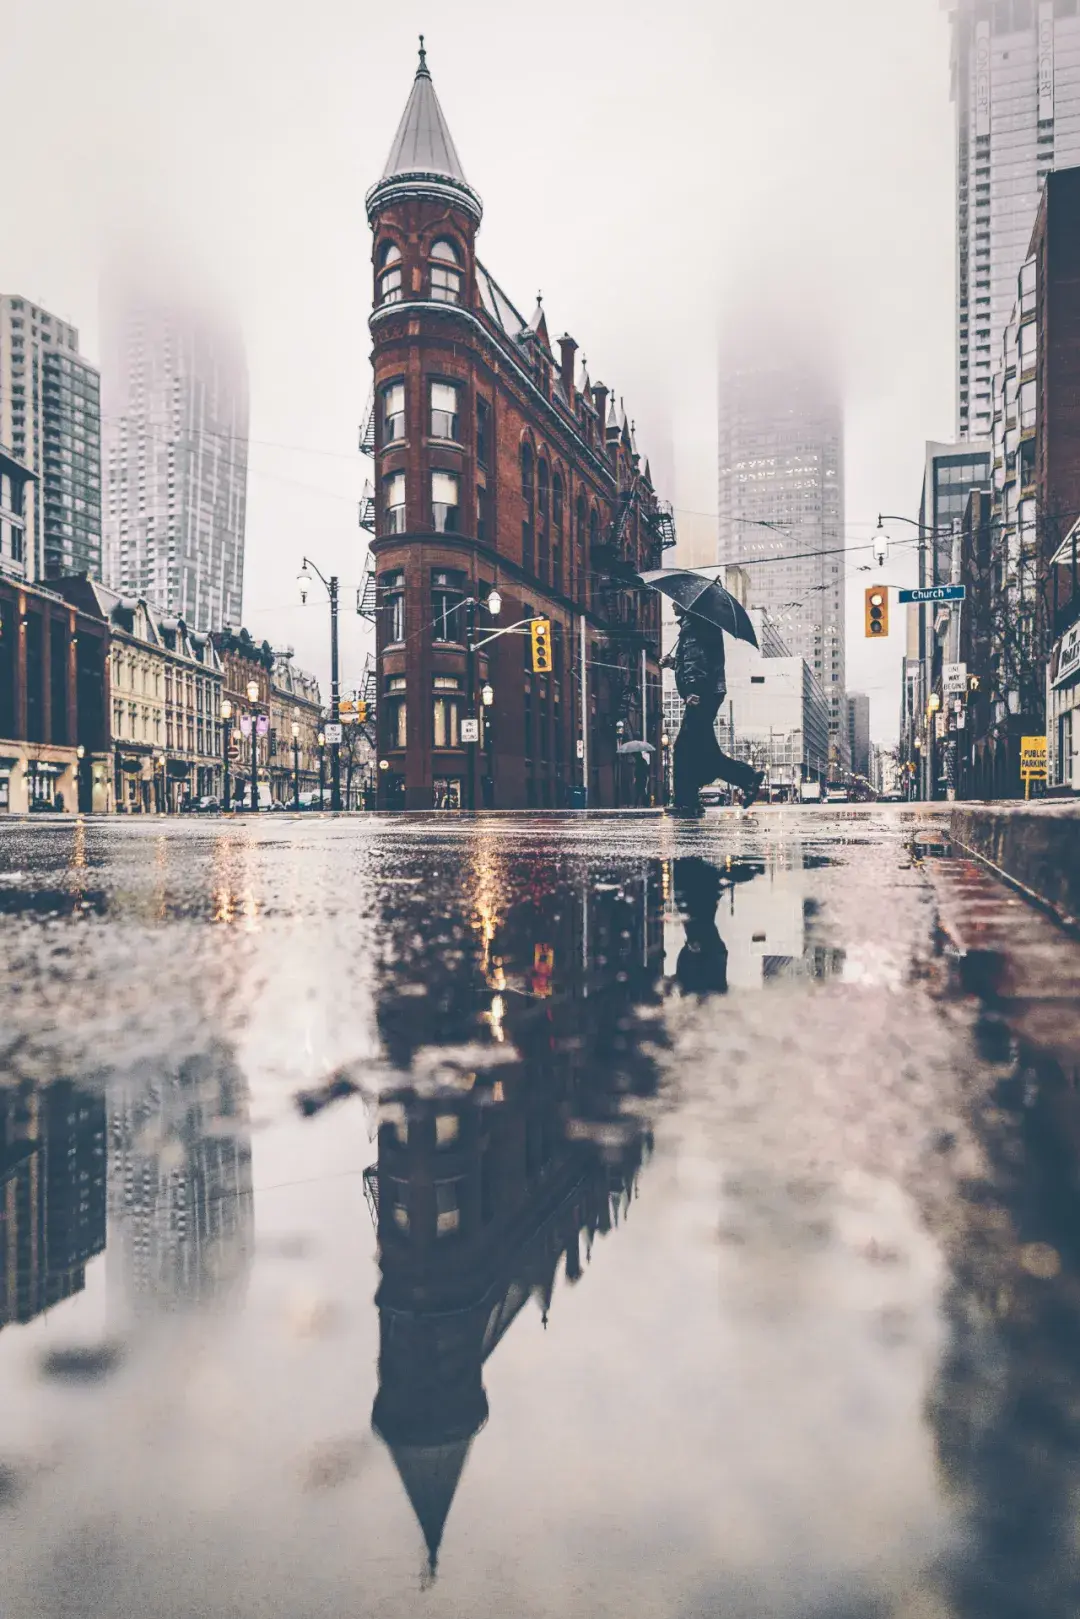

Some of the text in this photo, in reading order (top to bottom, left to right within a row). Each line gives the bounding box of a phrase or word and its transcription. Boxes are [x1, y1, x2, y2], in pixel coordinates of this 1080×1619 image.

[911, 588, 944, 600] Church
[944, 682, 966, 690] BEGINS
[1024, 749, 1046, 758] PUBLIC
